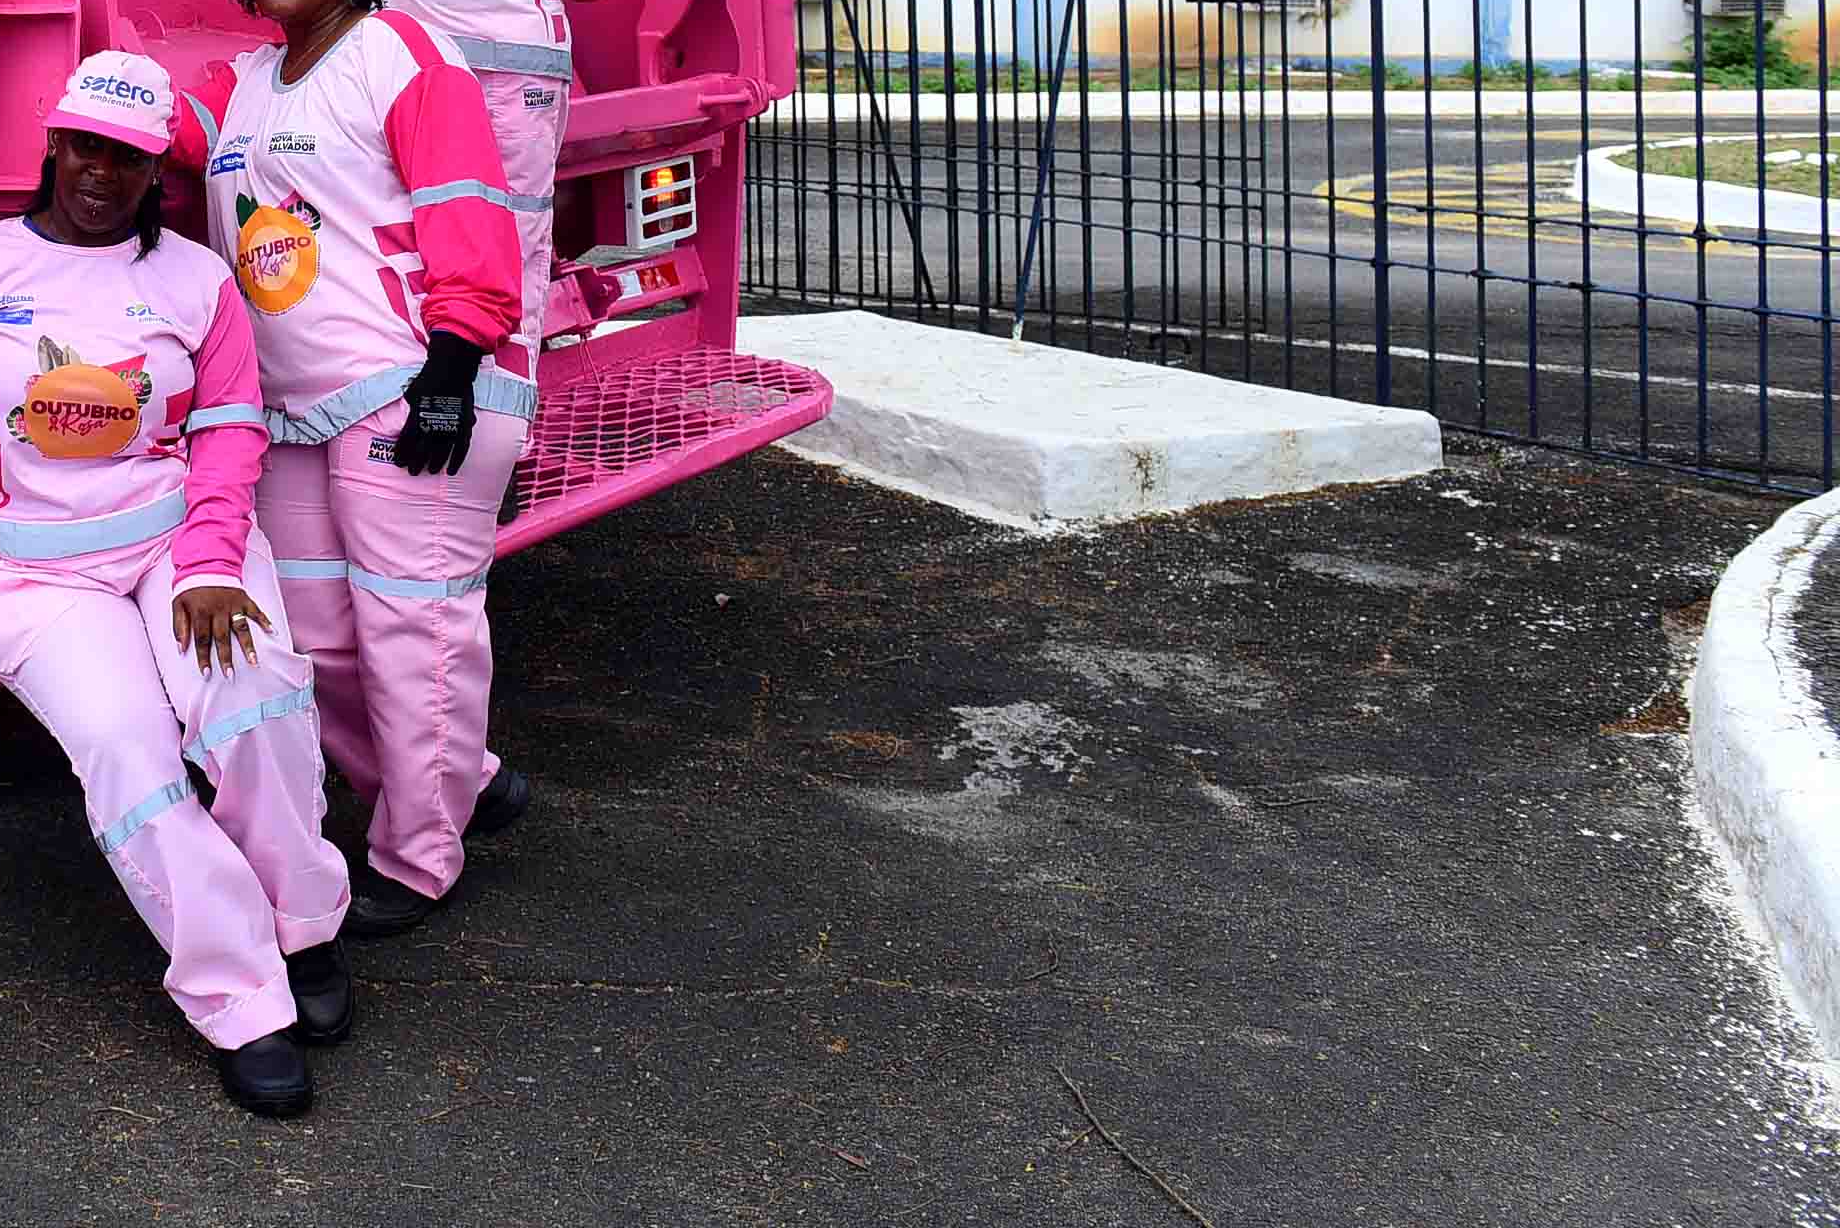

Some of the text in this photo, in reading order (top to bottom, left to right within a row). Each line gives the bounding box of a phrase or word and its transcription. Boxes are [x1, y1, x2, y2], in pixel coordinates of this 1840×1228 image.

[79, 75, 155, 106] sotero
[89, 93, 136, 109] ambiental
[271, 135, 293, 143] NOVA
[268, 143, 316, 152] SALVADOR
[239, 236, 311, 269] OUTUBRO
[31, 400, 137, 421] OUTUBRO
[369, 441, 395, 452] NOV
